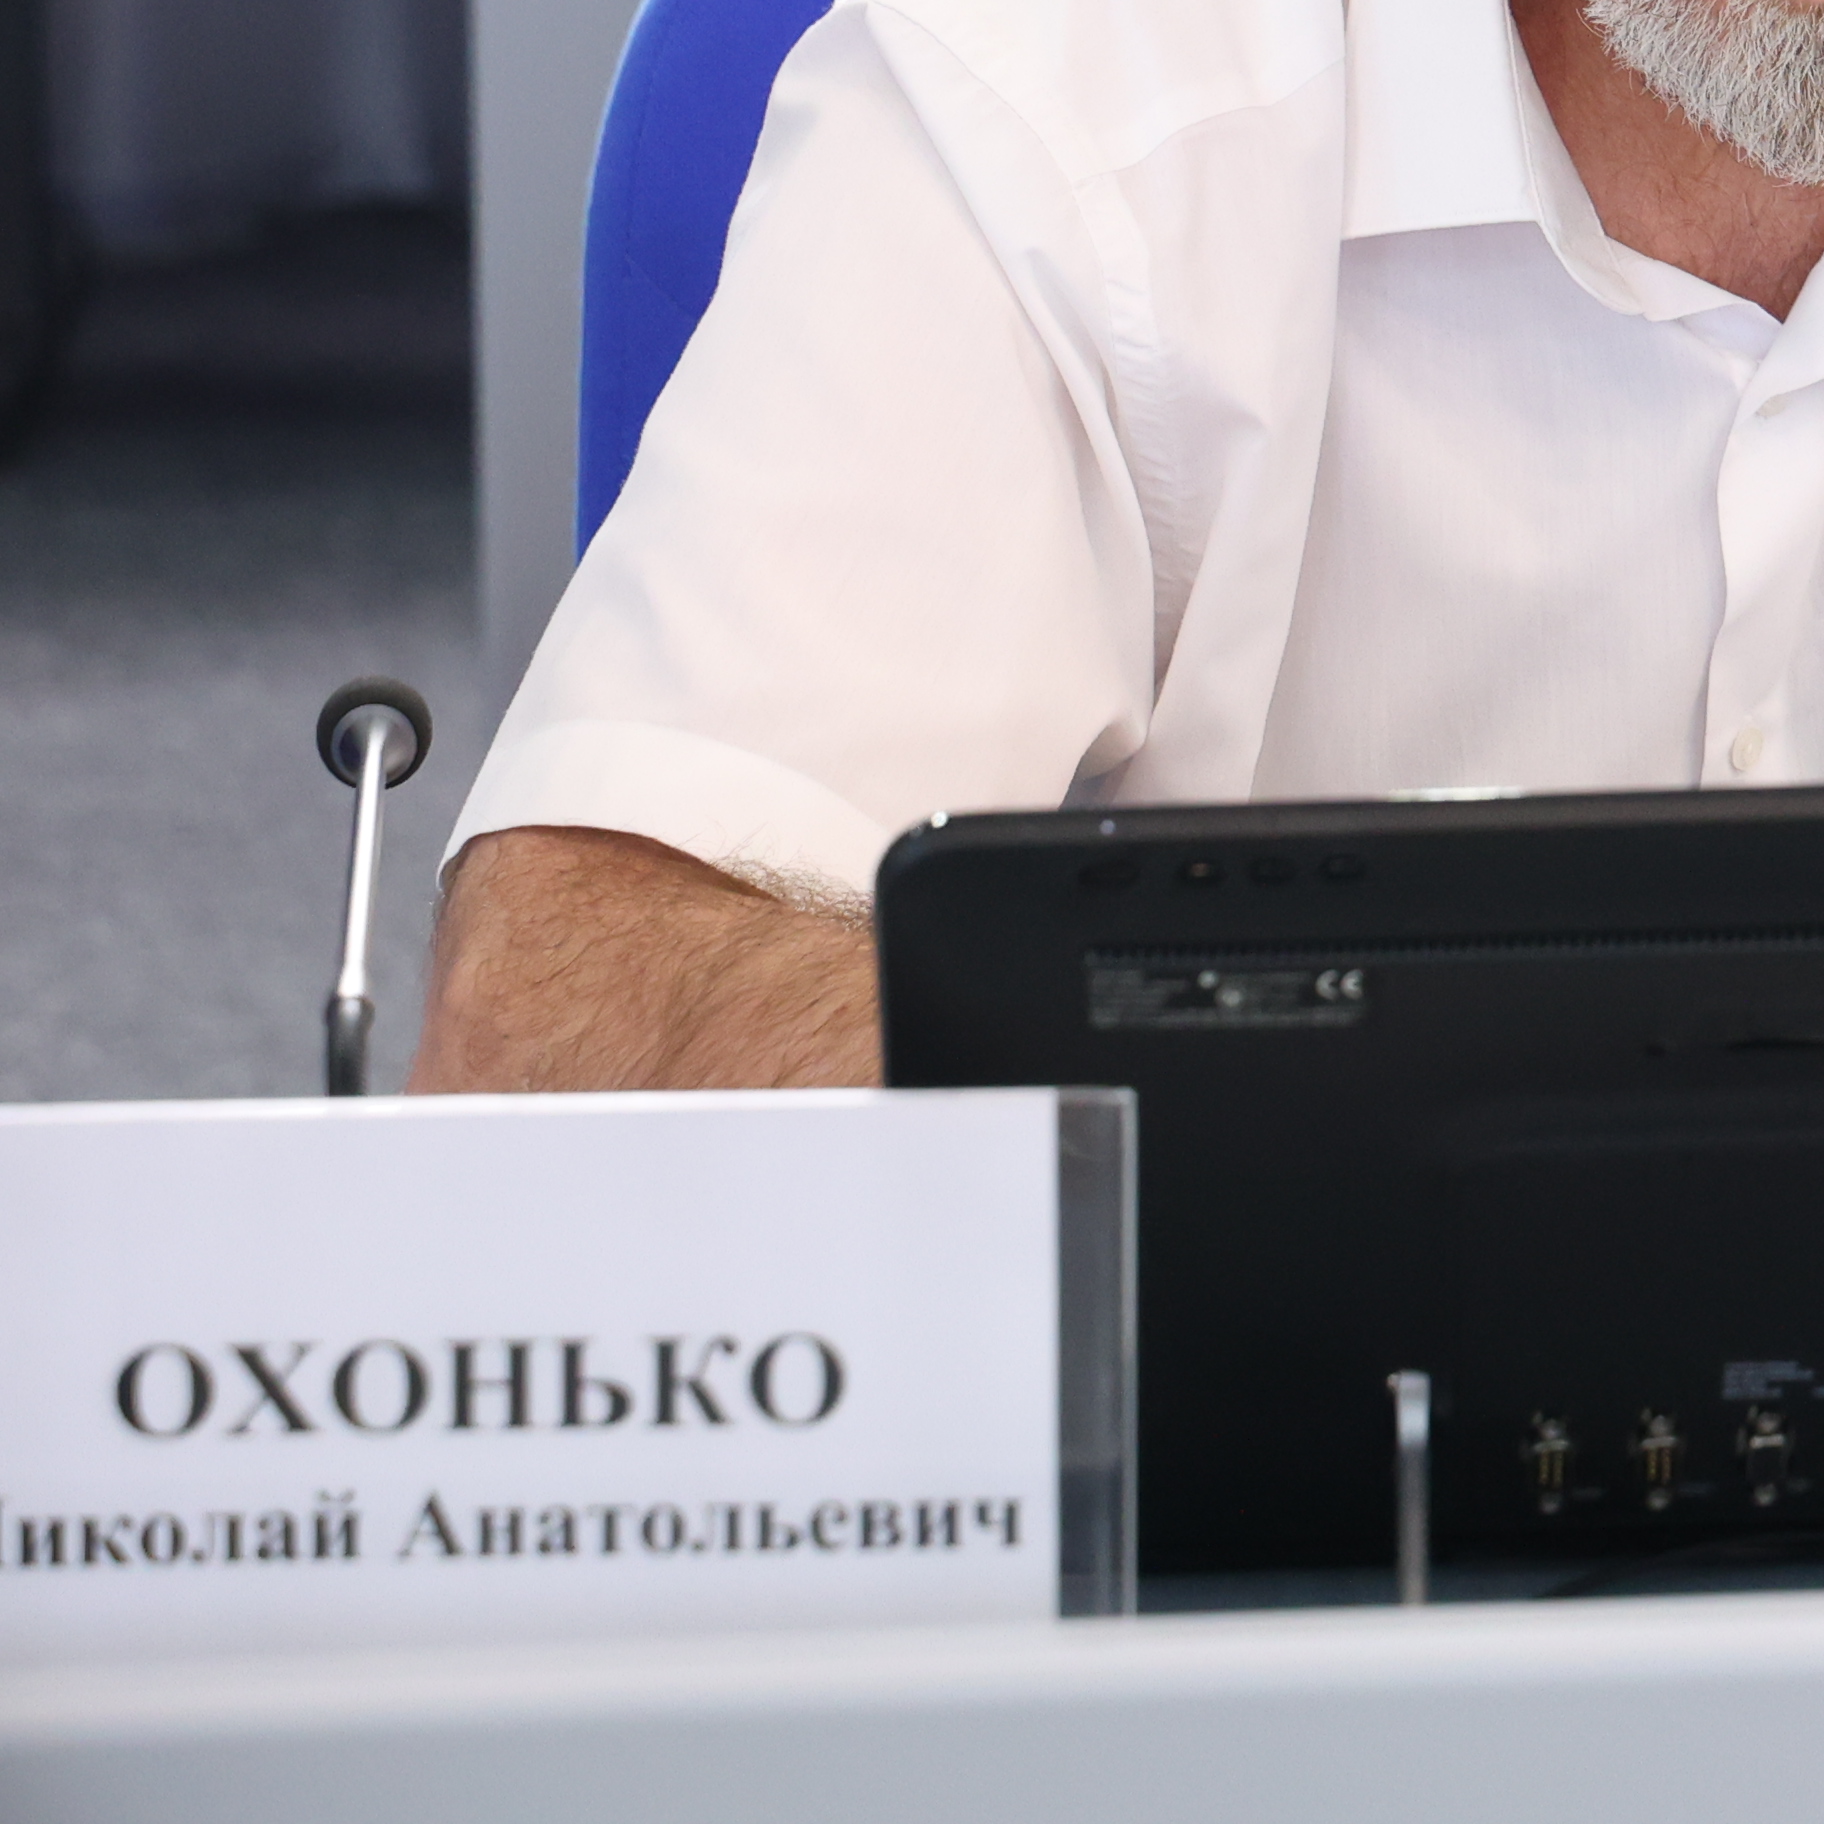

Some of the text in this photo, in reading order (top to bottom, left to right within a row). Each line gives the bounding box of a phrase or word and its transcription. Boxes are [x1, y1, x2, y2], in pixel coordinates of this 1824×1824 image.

[112, 1332, 847, 1438] ОХОНЬКО
[0, 1490, 1023, 1570] иколай Анатольевич
